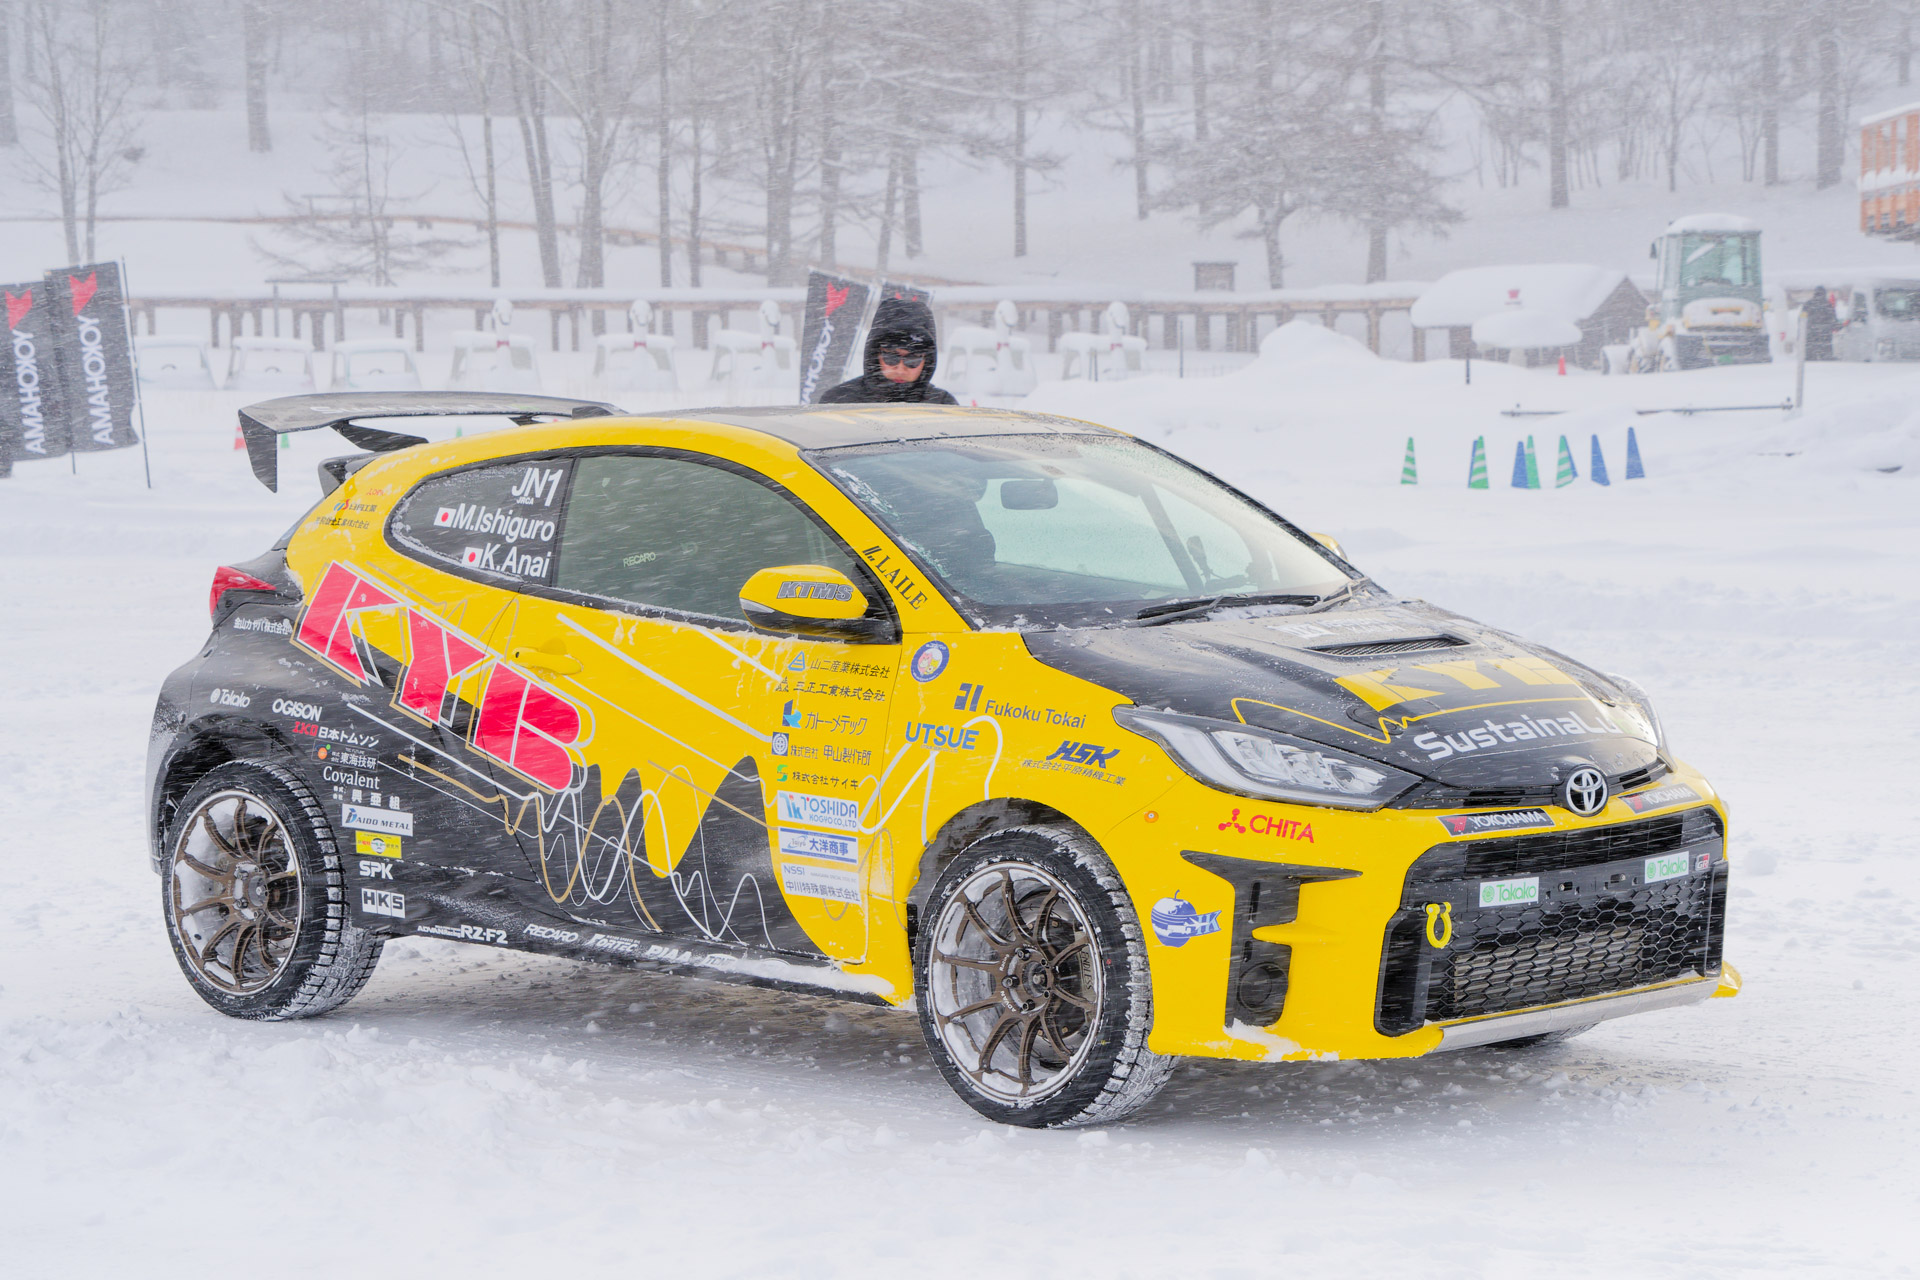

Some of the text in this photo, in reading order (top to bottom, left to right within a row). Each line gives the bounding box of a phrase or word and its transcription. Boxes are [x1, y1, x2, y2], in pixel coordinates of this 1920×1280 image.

[511, 467, 563, 507] JN1
[452, 503, 555, 543] M.Ishiguro
[479, 543, 552, 578] K.Anai
[623, 552, 656, 568] RECARO
[776, 581, 854, 602] KTMS
[874, 556, 928, 611] LAILE
[296, 560, 583, 793] KYB
[810, 658, 890, 678] 山二産業株式会社
[219, 688, 251, 708] Takako
[272, 698, 322, 722] OGISON
[984, 700, 1087, 729] Fukoku Tokai
[805, 711, 868, 736] カトーメテック
[318, 726, 380, 748] 日本トムソン
[905, 722, 979, 750] UTSUE
[340, 752, 377, 769] 東海技研
[790, 744, 818, 759] 株式会社
[1046, 740, 1120, 769] HSK
[323, 766, 380, 790] Covalent
[800, 796, 857, 818] TOSHIDA
[381, 820, 411, 831] METAL
[1250, 814, 1314, 843] CHITA
[1468, 811, 1547, 828] YOKOHAMA
[809, 838, 849, 856] 大洋商事
[359, 860, 393, 880] SPK
[1657, 857, 1688, 877] Takako
[363, 890, 404, 910] HKS
[1496, 882, 1537, 901] Takako
[523, 923, 579, 943] RECARO
[646, 945, 691, 963] PIAA
